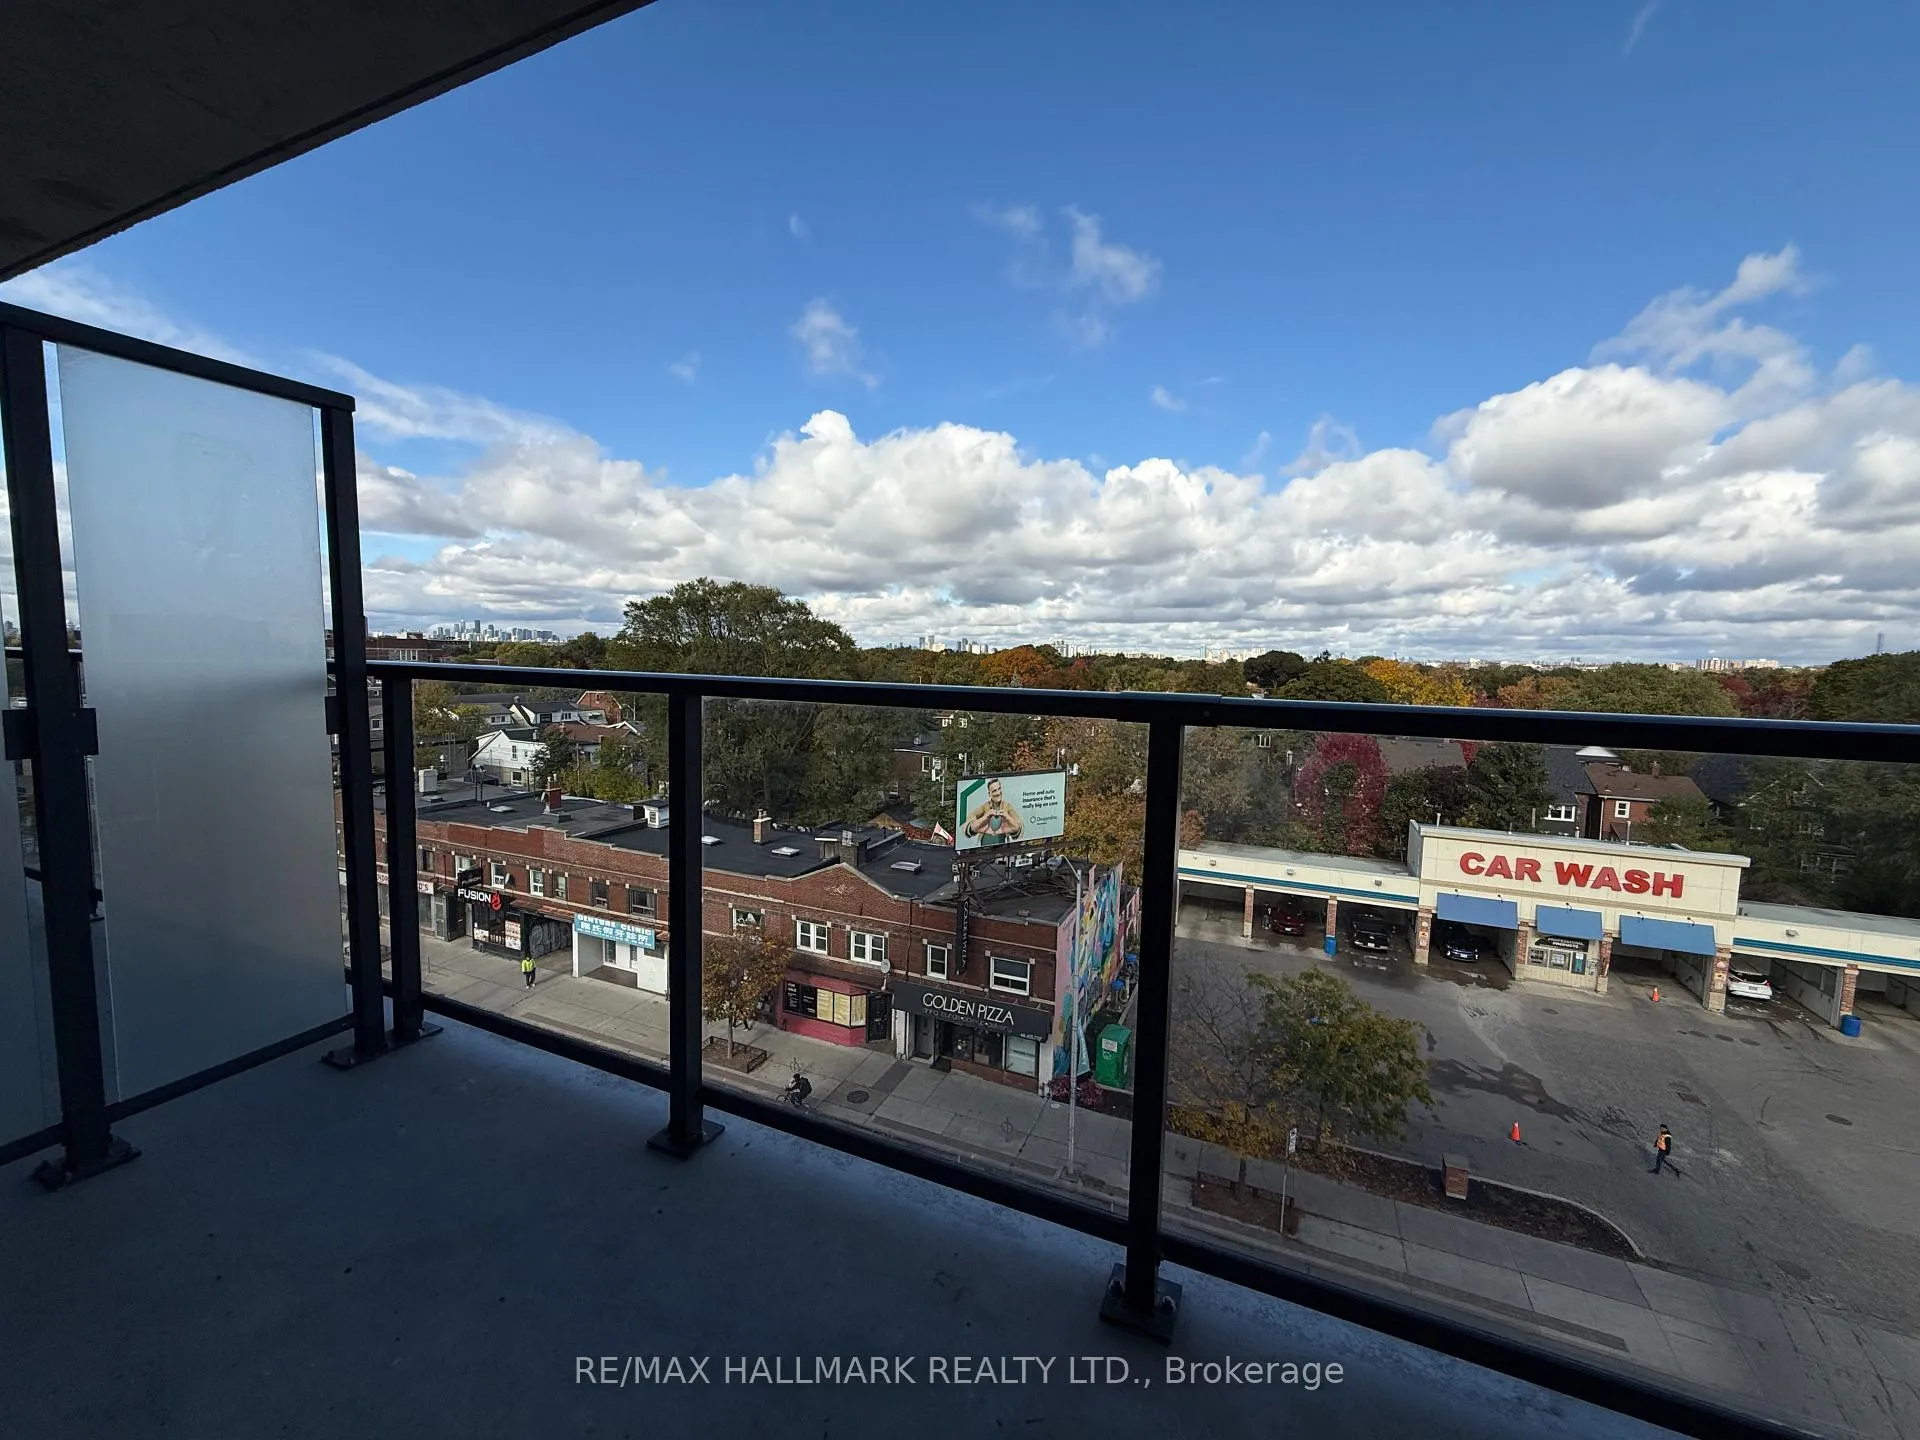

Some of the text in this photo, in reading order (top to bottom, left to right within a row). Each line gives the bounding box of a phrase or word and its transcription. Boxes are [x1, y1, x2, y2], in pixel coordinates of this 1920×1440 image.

[1460, 852, 1684, 898] CAR WASH
[457, 888, 491, 903] FUSION
[577, 914, 652, 936] DENTURE CLINIC
[922, 993, 976, 1017] GOLDEN
[977, 1004, 1015, 1026] PIZZA
